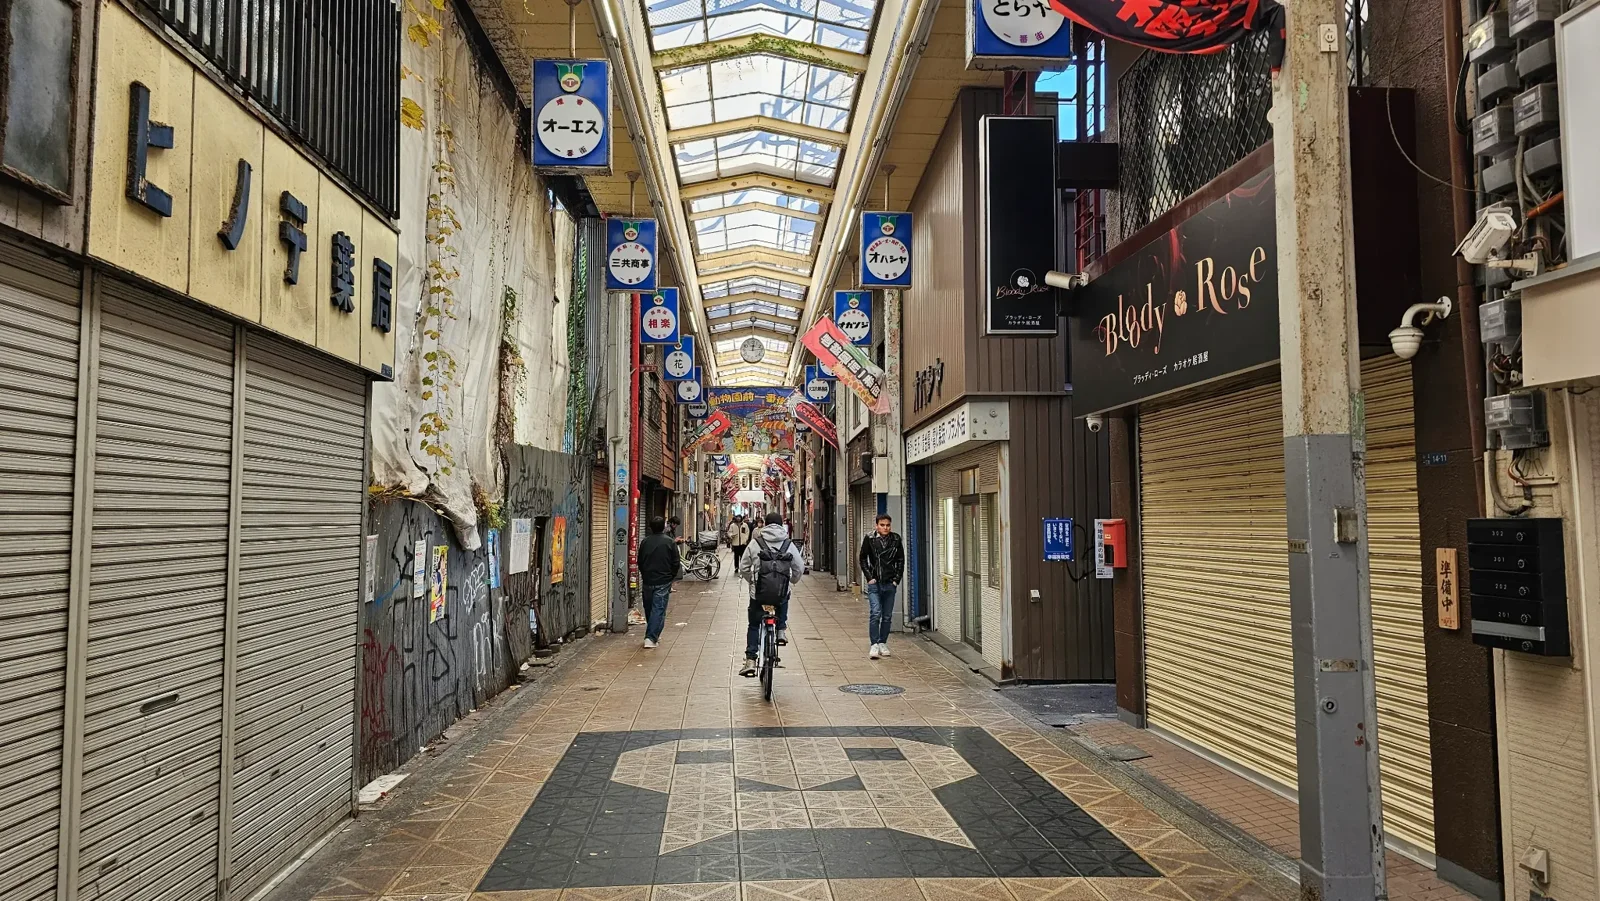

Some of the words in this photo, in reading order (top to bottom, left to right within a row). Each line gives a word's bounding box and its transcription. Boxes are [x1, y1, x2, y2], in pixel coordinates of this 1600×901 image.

[1003, 31, 1045, 43] 一番街
[543, 118, 599, 135] オーエス
[611, 258, 649, 268] 三共商事
[1195, 246, 1266, 315] Rose
[648, 319, 671, 329] 相楽
[673, 359, 684, 369] 花
[1133, 365, 1168, 385] ブラッディ・ローズ
[1174, 351, 1209, 371] カラオケ居酒屋
[1440, 560, 1454, 612] 準備中
